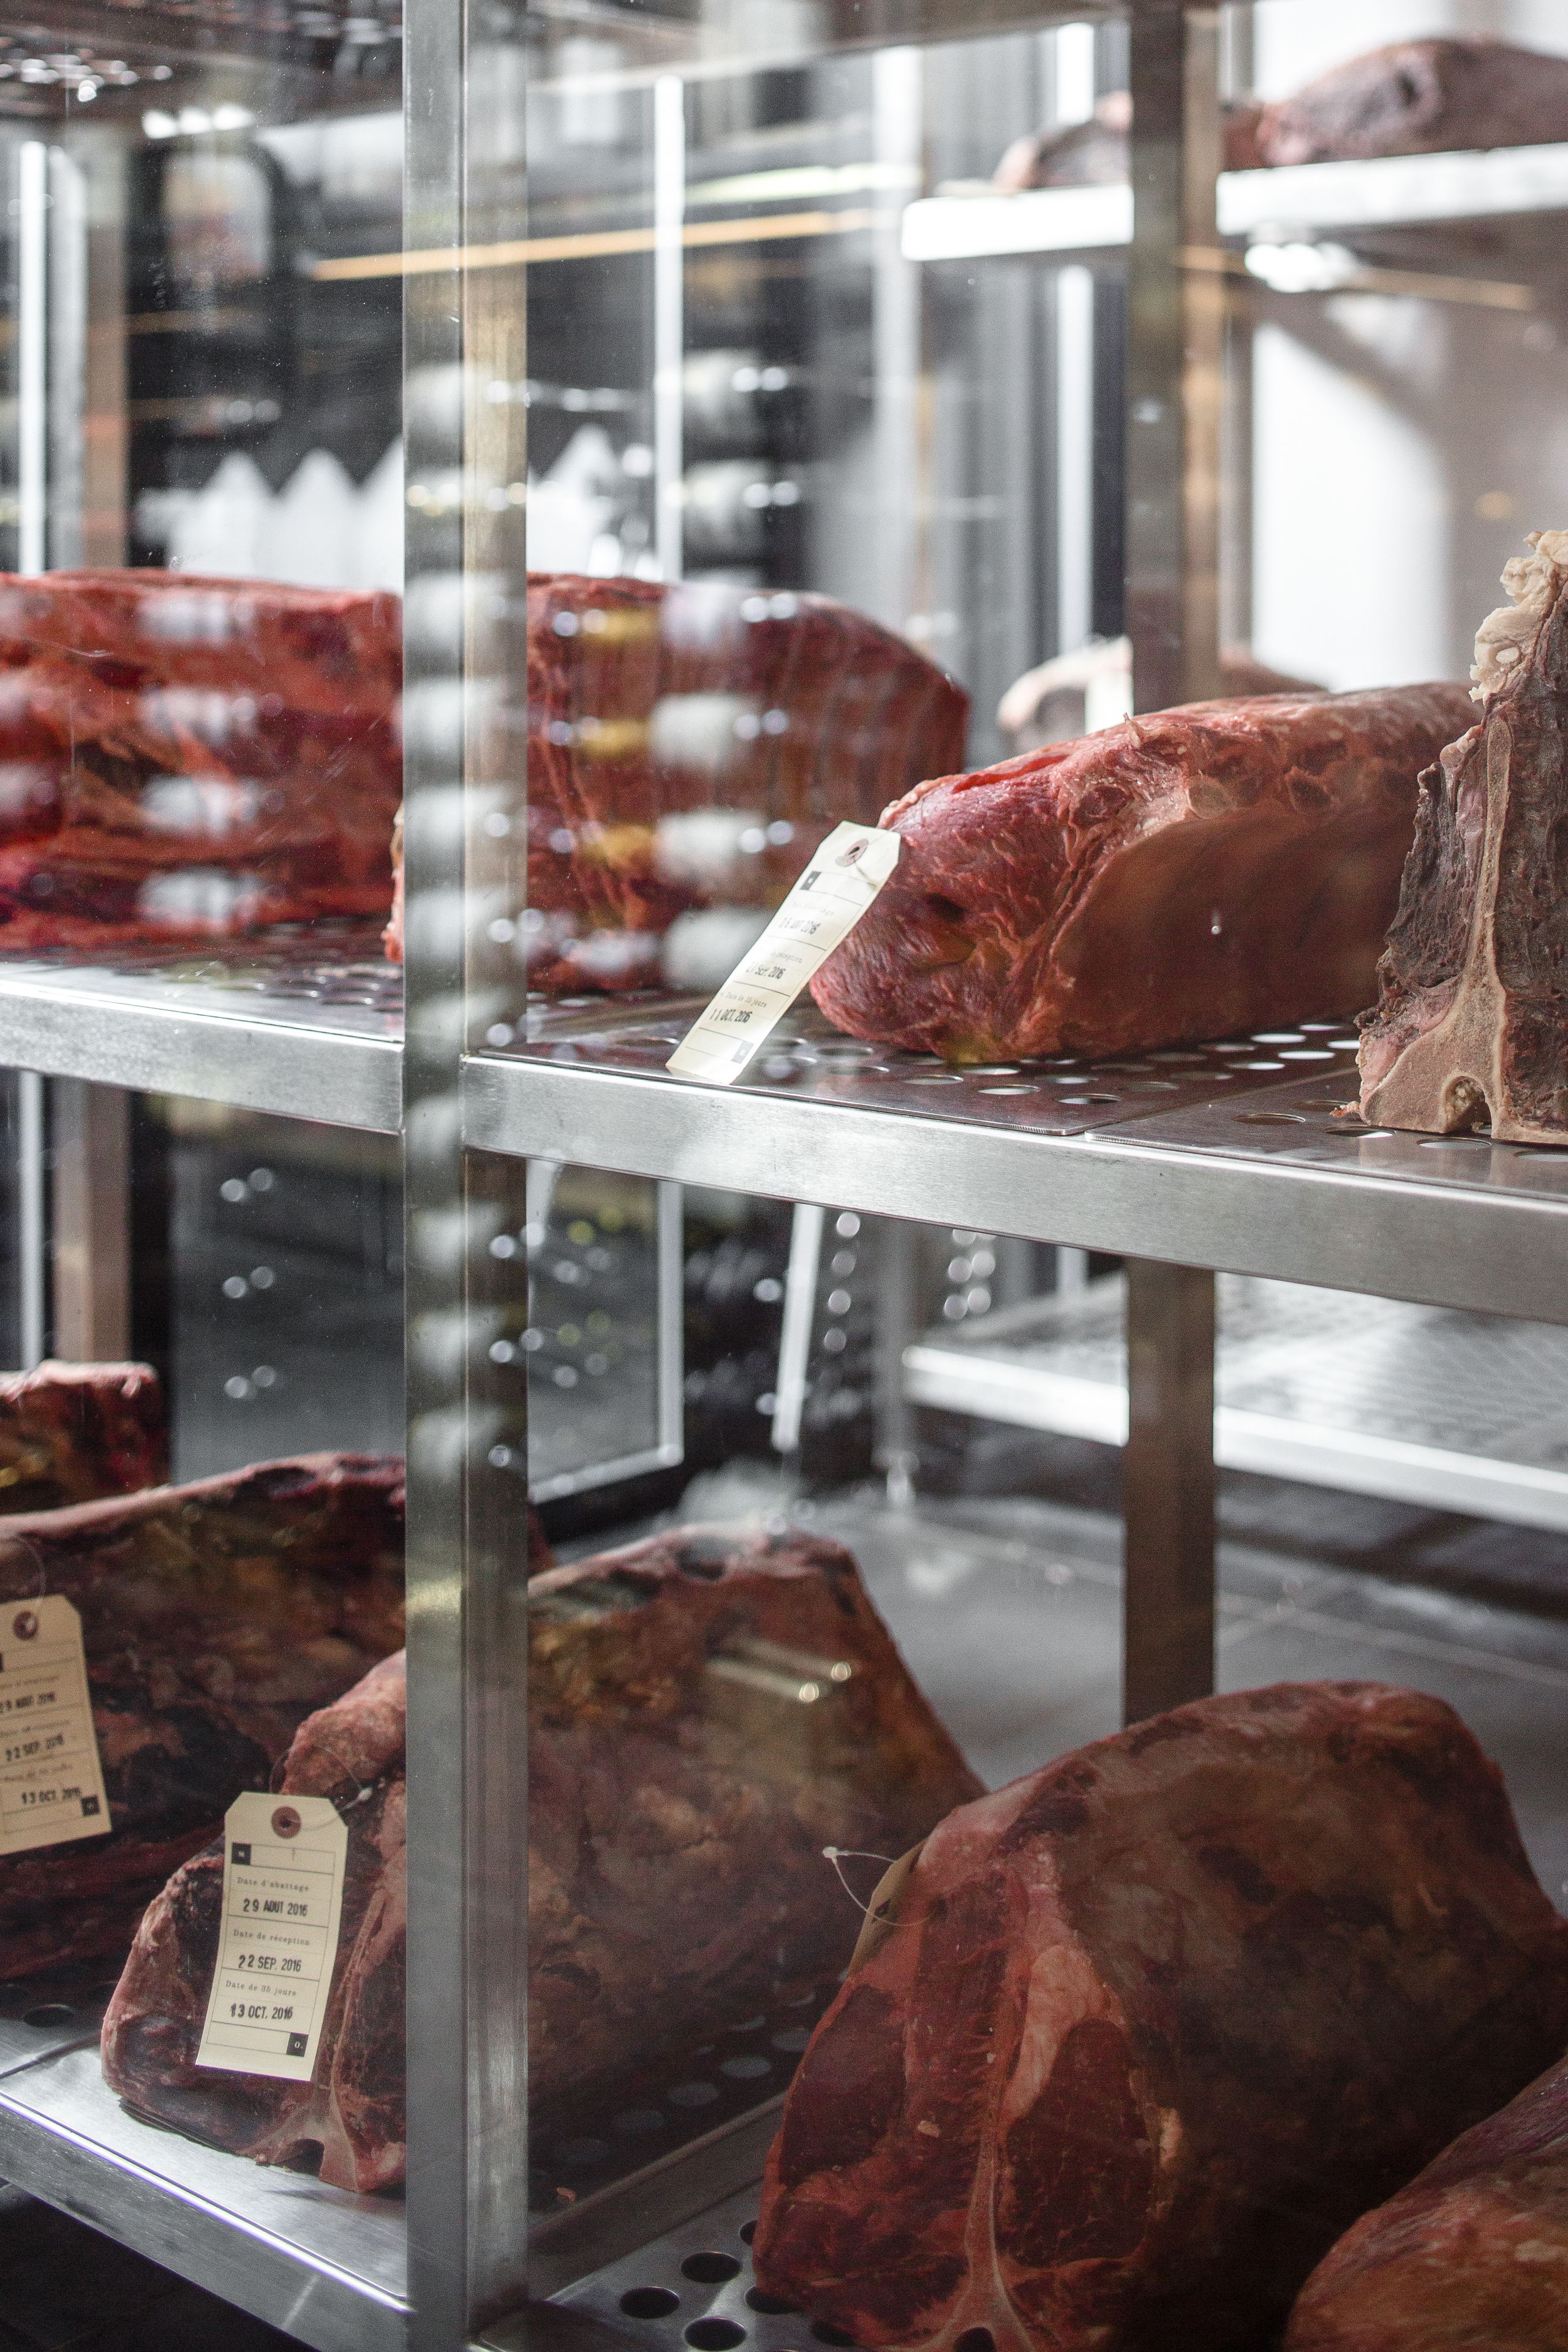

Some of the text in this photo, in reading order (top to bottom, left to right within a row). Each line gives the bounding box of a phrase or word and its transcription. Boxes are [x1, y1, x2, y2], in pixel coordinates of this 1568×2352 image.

[734, 1010, 753, 1023] 2016
[237, 1877, 258, 1886] Date
[243, 1898, 259, 1912] 29
[287, 1902, 308, 1917] 2016
[233, 1929, 253, 1938] Date
[257, 1931, 266, 1940] de
[238, 1954, 255, 1969] 22
[281, 1958, 301, 1972] 2016
[225, 1980, 245, 1989] Date
[249, 1983, 258, 1991] de
[274, 1987, 296, 1996] jours
[230, 2003, 293, 2020] 13 OCT. 2016
